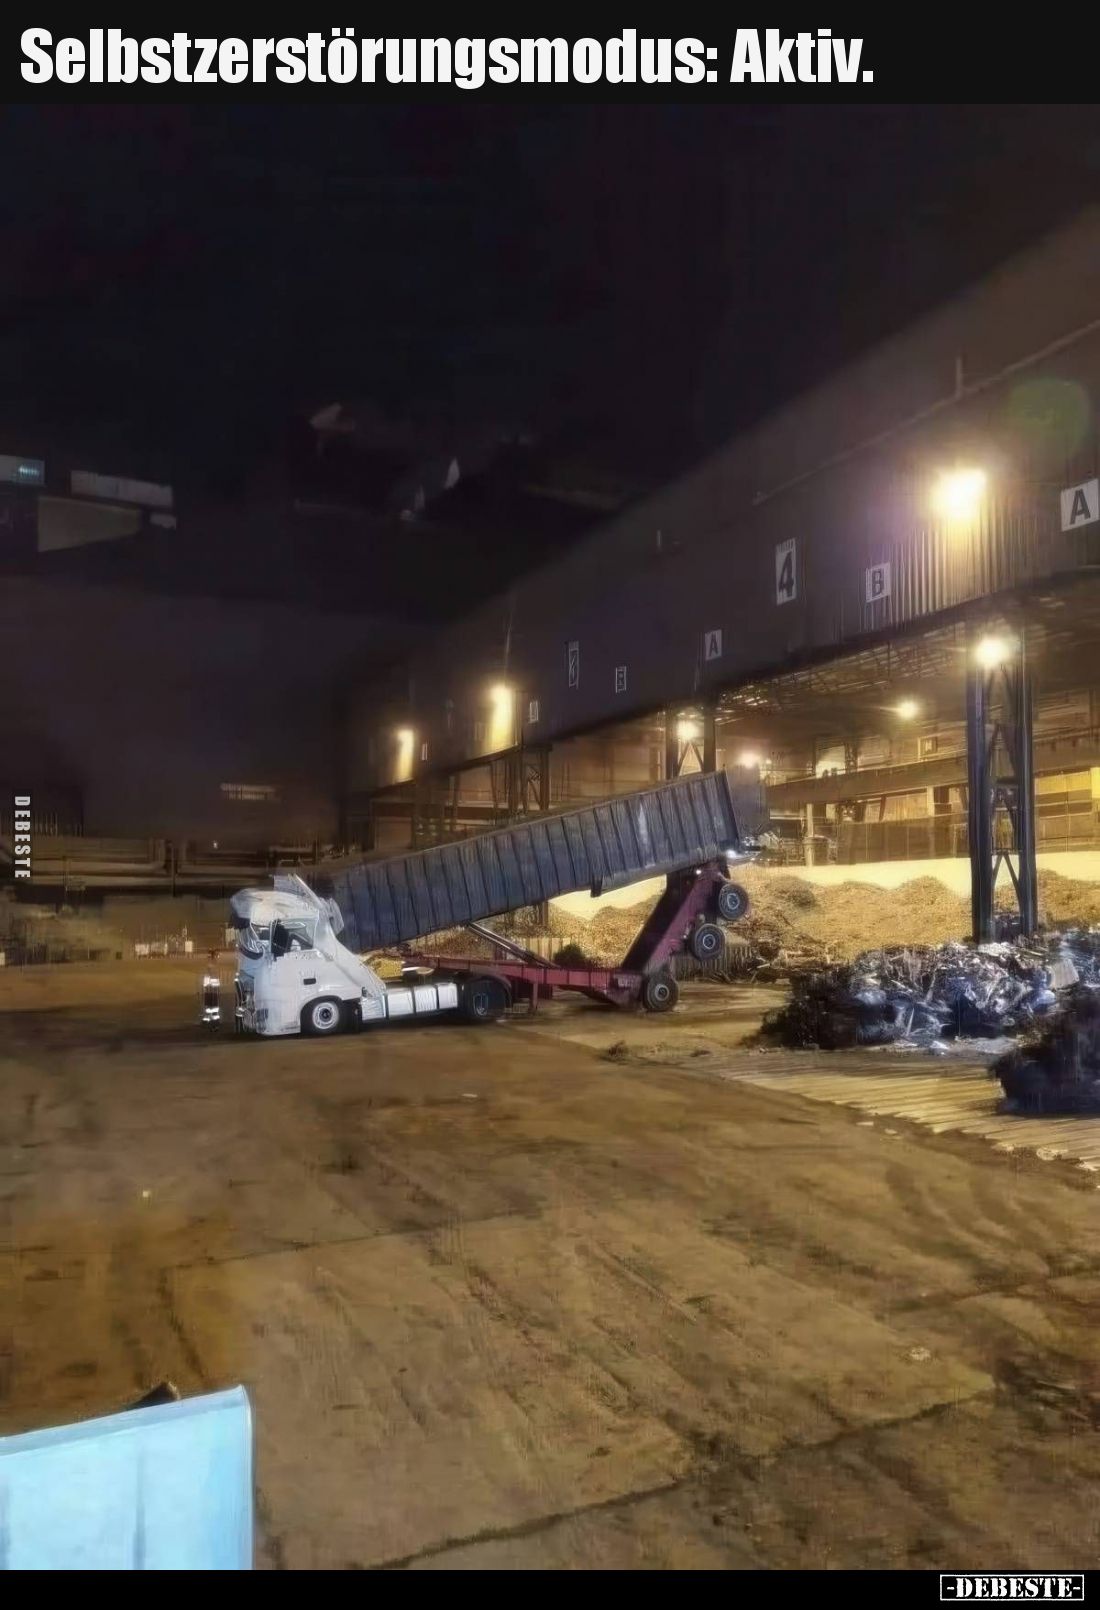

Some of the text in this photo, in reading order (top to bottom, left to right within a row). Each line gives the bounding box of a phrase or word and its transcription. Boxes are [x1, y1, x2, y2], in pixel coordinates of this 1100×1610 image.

[1069, 488, 1091, 525] A
[778, 550, 794, 598] 4
[870, 568, 885, 597] B
[708, 633, 719, 658] A
